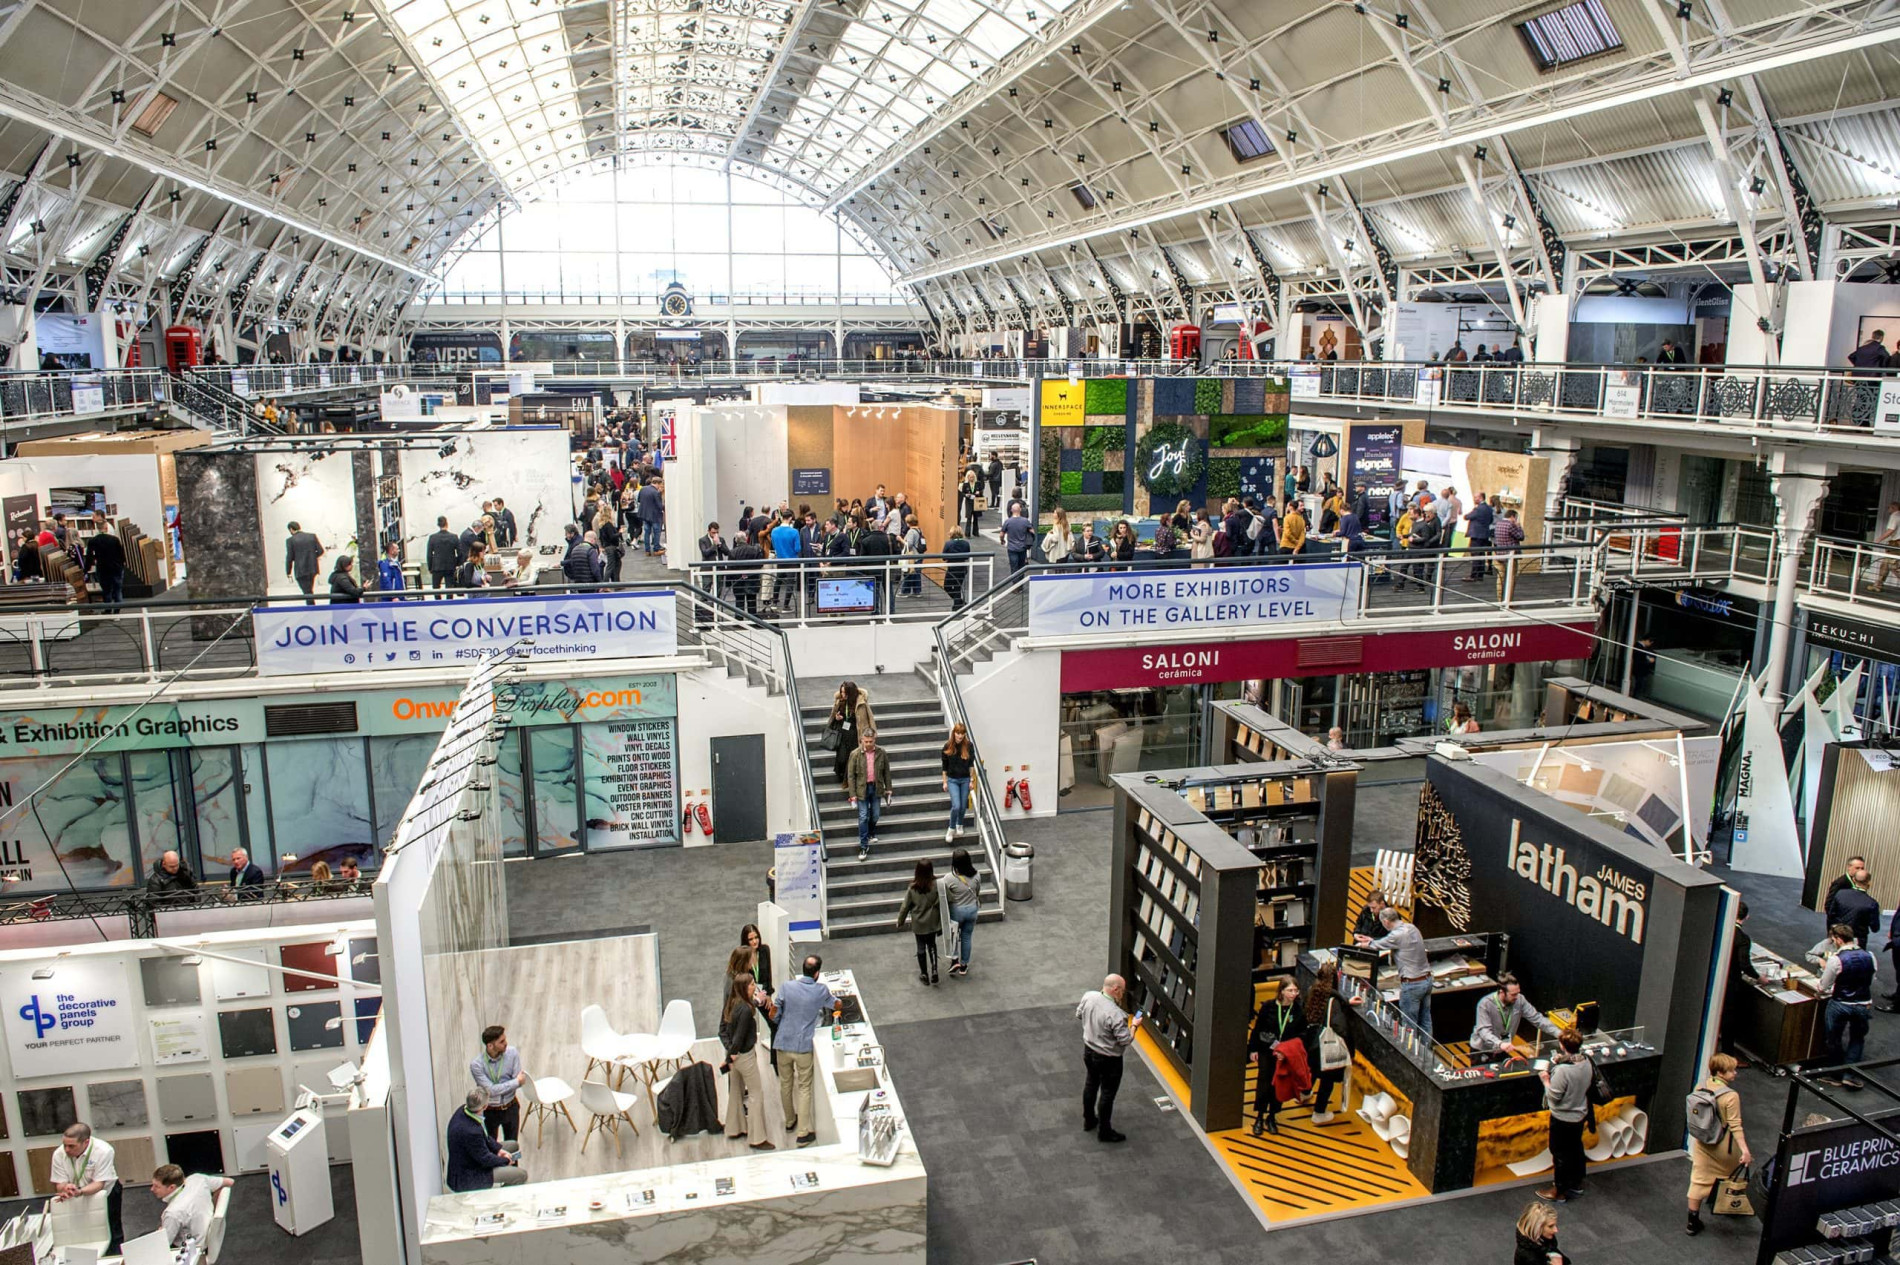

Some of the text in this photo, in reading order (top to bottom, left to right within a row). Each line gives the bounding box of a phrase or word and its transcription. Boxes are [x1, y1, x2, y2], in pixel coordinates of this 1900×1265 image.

[1367, 432, 1395, 441] applelec
[1150, 438, 1189, 479] Joy!
[1355, 458, 1393, 471] signpik
[1367, 487, 1394, 496] neon
[1109, 577, 1290, 600] MORE EXHIBITORS
[1080, 601, 1314, 627] ON THE GALLERY LEVEL
[275, 610, 656, 648] JOIN THE CONVERSATION
[1813, 622, 1874, 644] TEKUCHI
[1453, 632, 1521, 650] SALONI
[1142, 650, 1220, 669] SALONI
[1467, 650, 1505, 659] cerámica
[1158, 668, 1202, 679] cerámica
[14, 721, 129, 743] Exhibition
[136, 714, 239, 737] Graphics
[608, 721, 669, 733] WINDOW STICKERS
[627, 731, 669, 742] WALL VINYLS
[625, 741, 670, 752] VINYL DECALS
[607, 751, 670, 763] PRINTS ONTO WOOD
[618, 761, 671, 773] FLOOR STICKERS
[602, 771, 671, 783] EXHIBITION GRAPHICS
[1738, 755, 1752, 797] MAGNA
[618, 780, 672, 792] EVENT GRAPHICS
[610, 790, 672, 803] OUTDOOR BANNERS
[616, 800, 672, 812] POSTER PRINTING
[631, 810, 673, 821] CNC CUTTING
[610, 819, 673, 832] BRICK WALL VINYLS
[629, 829, 674, 840] INSTALLATION
[1507, 818, 1645, 945] latham
[1597, 864, 1646, 901] JAMES
[57, 994, 75, 1003] the
[58, 998, 117, 1011] decorative
[60, 1009, 97, 1021] panels
[61, 1018, 94, 1030] group
[25, 1035, 121, 1050] YOUR PERFECT PARTNER
[1823, 1137, 1900, 1163] BLUEPRIN
[1820, 1150, 1900, 1180] CERAMICS
